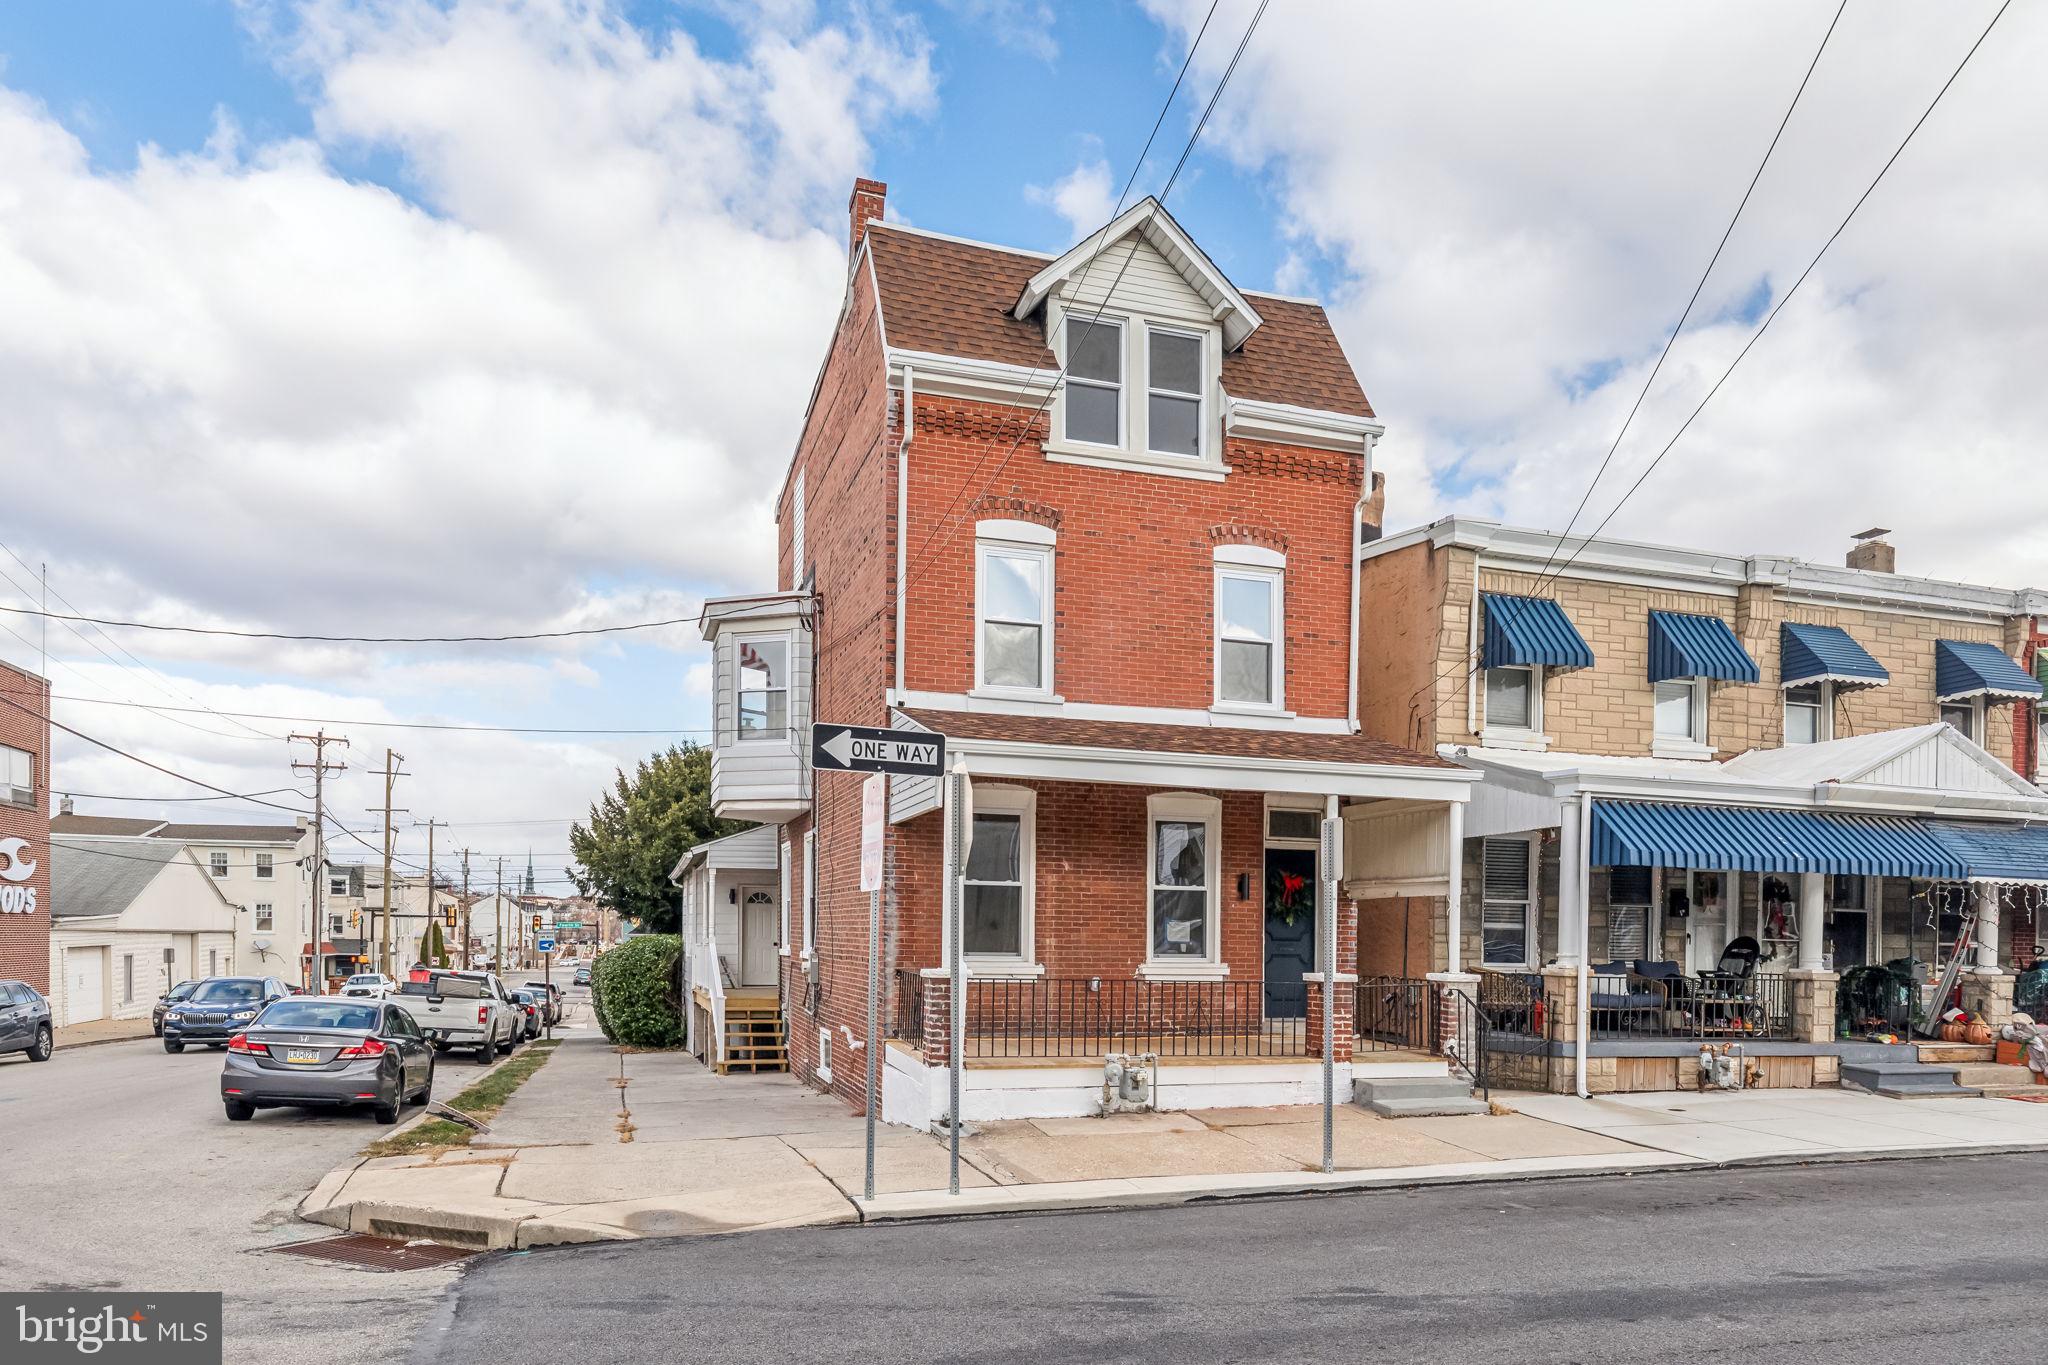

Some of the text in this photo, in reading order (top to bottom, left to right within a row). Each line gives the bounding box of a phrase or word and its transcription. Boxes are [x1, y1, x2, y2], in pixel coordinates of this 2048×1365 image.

[851, 740, 935, 764] ONE WAY
[0, 885, 37, 914] ODS
